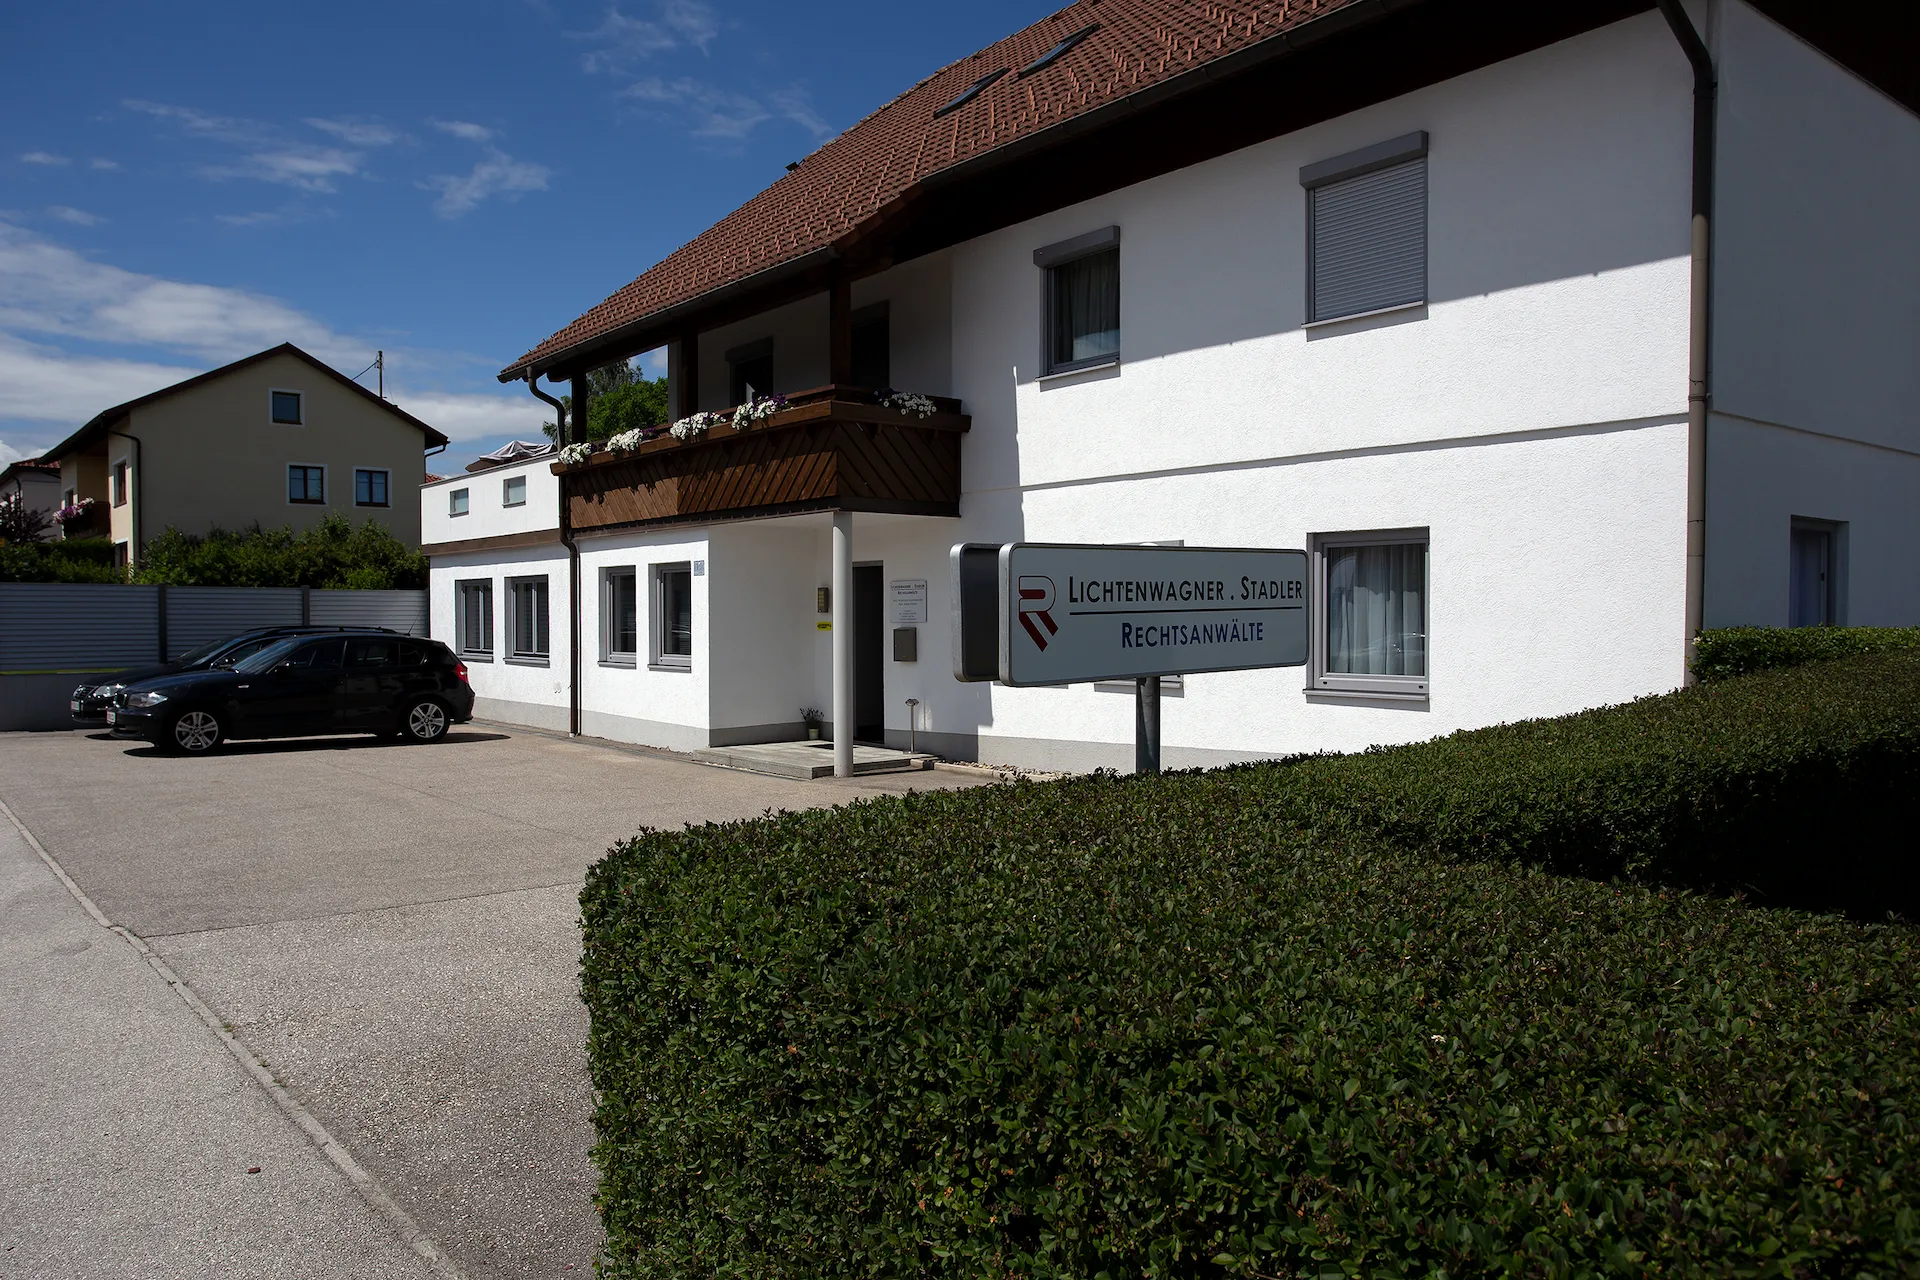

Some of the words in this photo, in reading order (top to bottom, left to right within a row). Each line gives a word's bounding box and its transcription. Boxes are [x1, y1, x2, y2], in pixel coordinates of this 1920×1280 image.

[1069, 576, 1224, 603] LICHTENWAGNER
[1240, 576, 1303, 600] STADLER
[1121, 618, 1264, 648] RECHTSANWÄLTE
